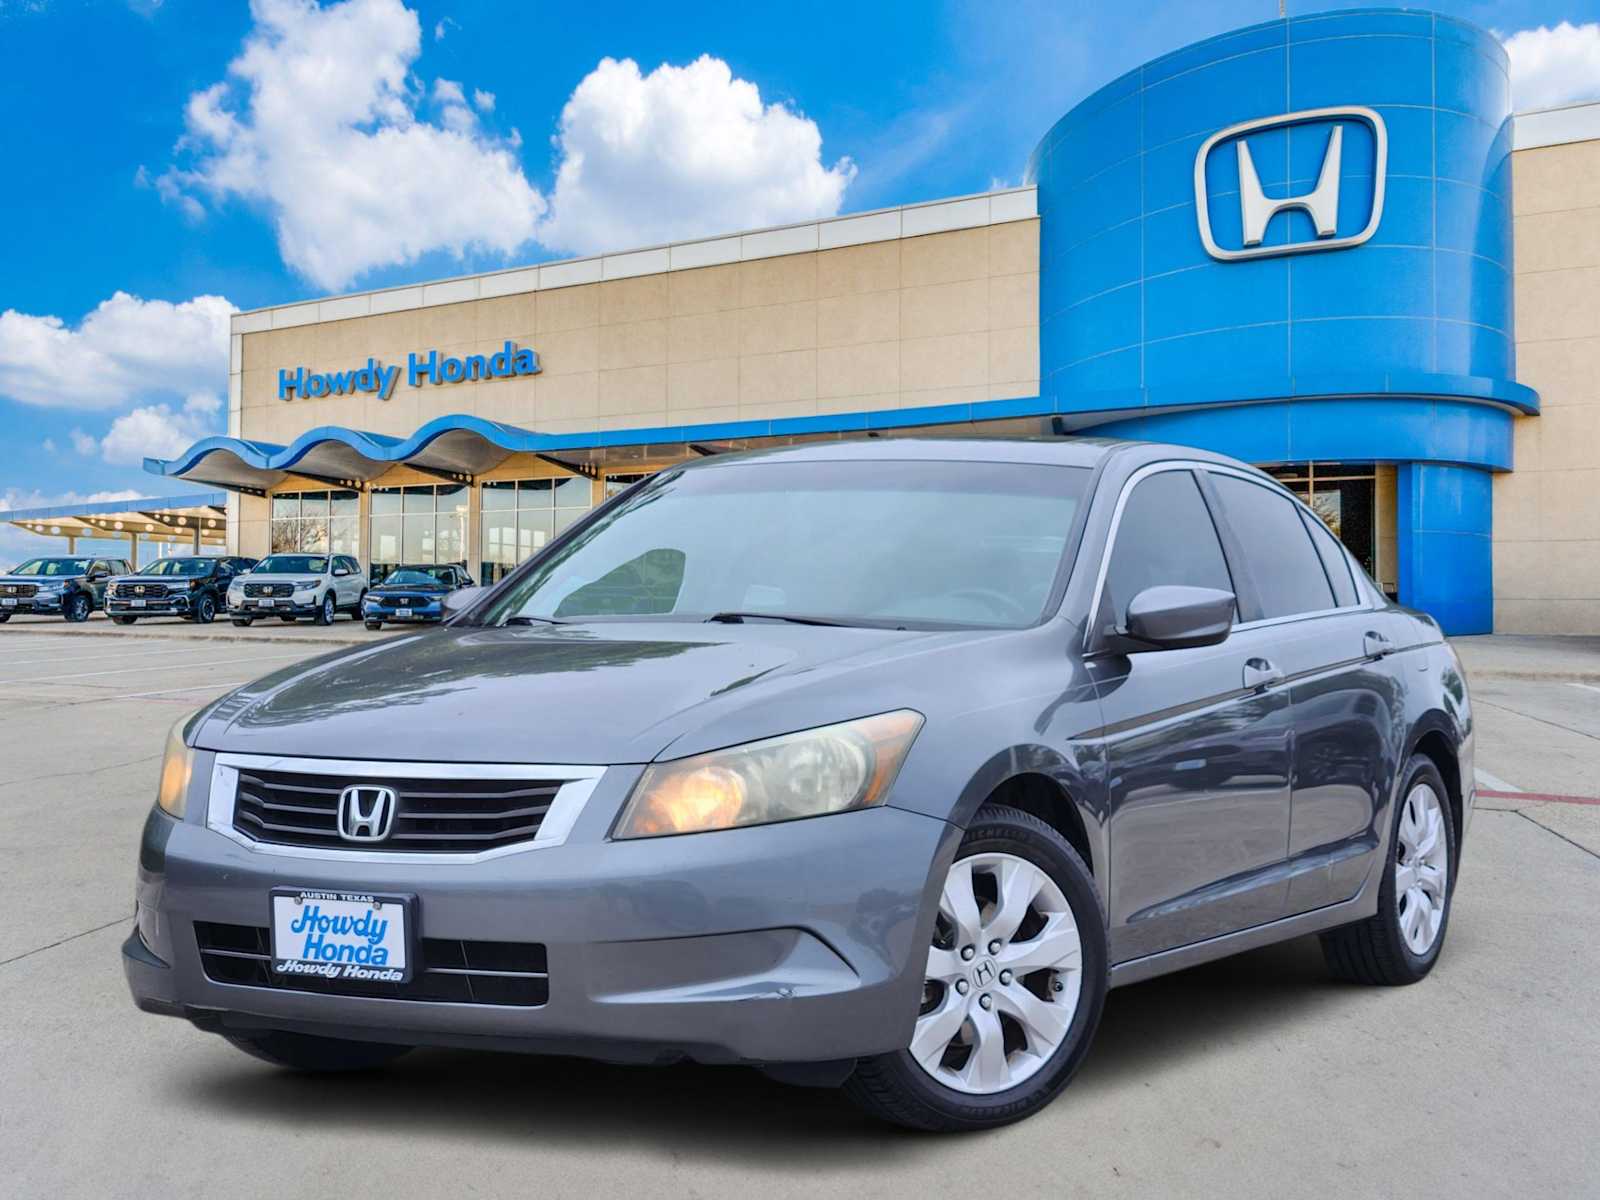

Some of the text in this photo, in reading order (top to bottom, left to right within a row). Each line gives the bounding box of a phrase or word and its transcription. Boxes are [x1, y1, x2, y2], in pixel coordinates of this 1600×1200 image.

[278, 340, 541, 400] Howdy Honda
[300, 891, 375, 903] AUSTIN TEXAS
[290, 904, 389, 945] Howdy
[302, 933, 389, 966] Honda
[276, 959, 403, 981] Howdy Honda
